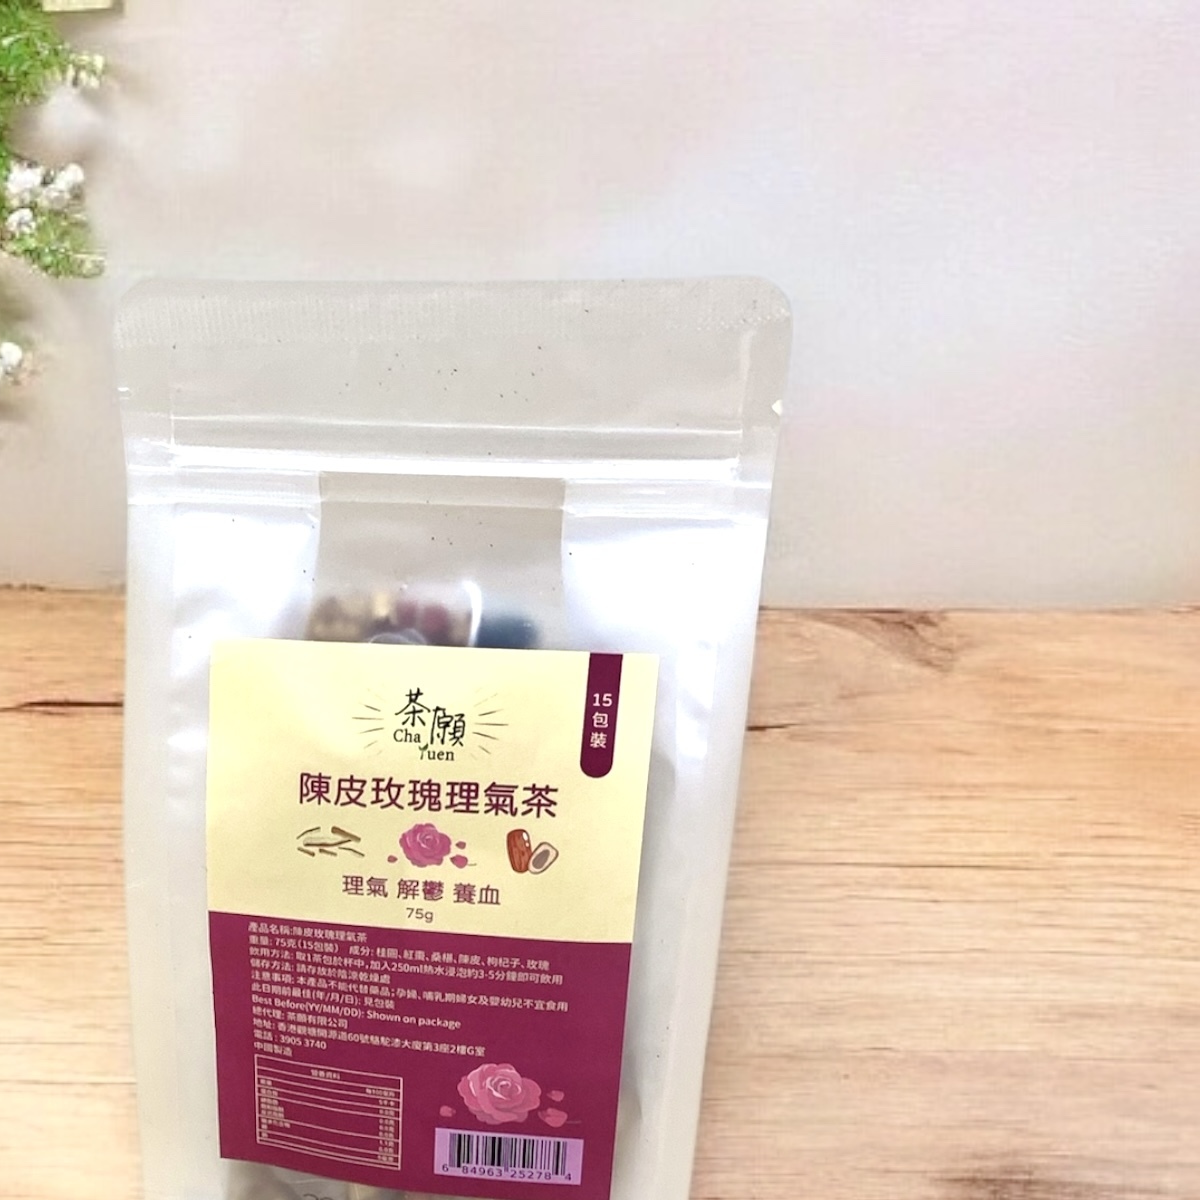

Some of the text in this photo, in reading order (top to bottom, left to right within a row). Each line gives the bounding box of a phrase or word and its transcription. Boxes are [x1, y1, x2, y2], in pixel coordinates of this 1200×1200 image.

[393, 728, 421, 744] Cha
[298, 772, 559, 819] 陳皮玫瑰理氣茶
[342, 875, 501, 906] 理氣 解鬱 養血
[406, 907, 434, 923] 75g
[252, 994, 273, 1003] Best
[367, 1010, 401, 1022] Shown
[403, 1015, 416, 1024] on
[418, 1017, 461, 1030] package
[280, 1034, 302, 1046] 3905
[304, 1038, 327, 1050] 3740
[442, 1163, 572, 1182] 6 84963 25278 4
